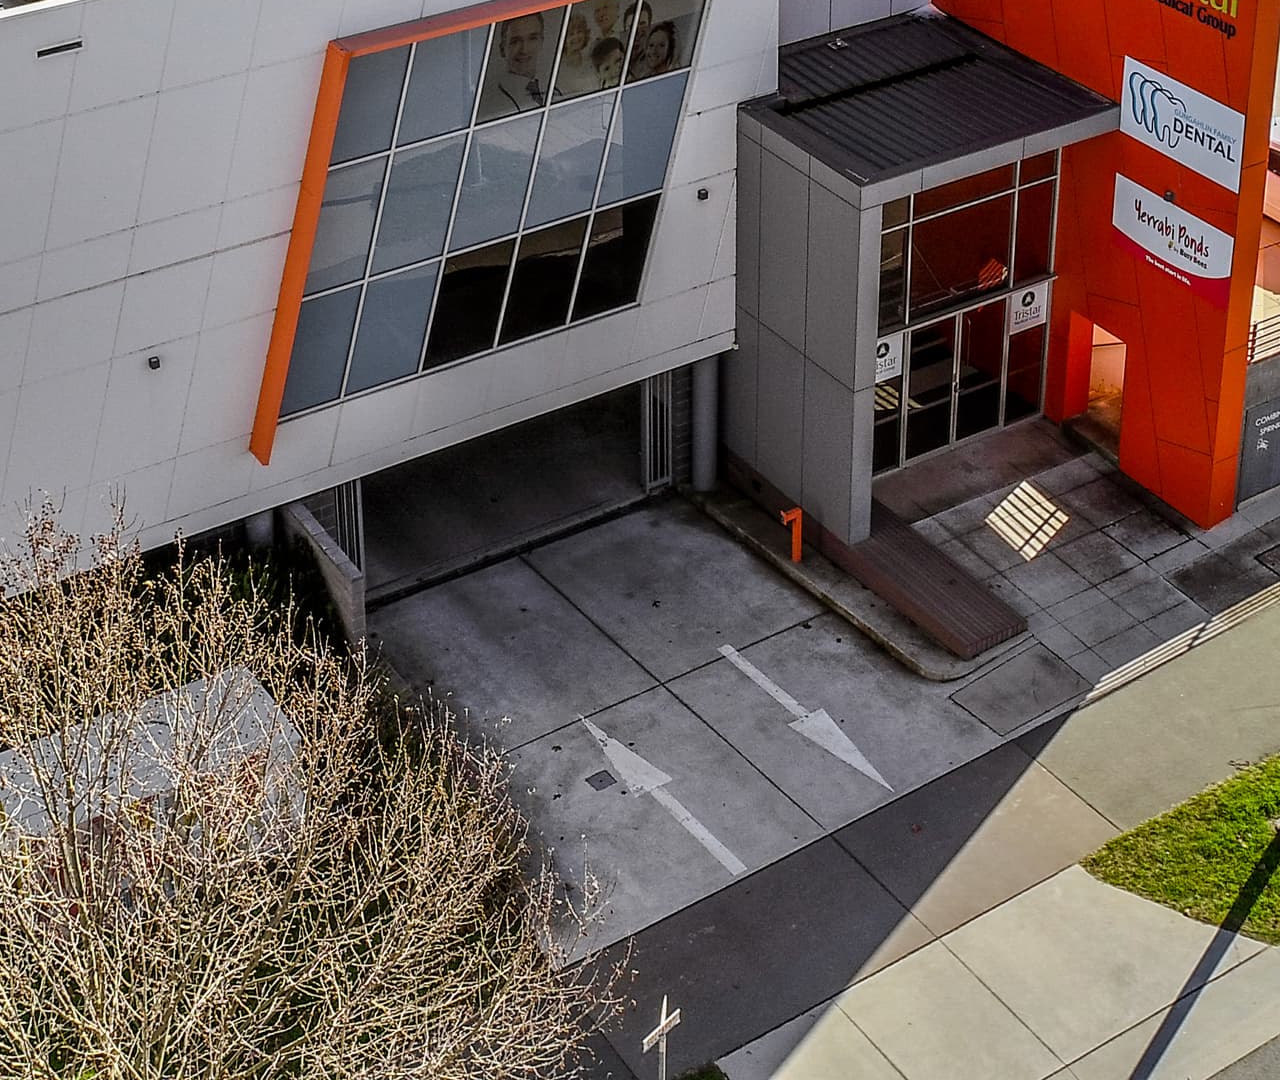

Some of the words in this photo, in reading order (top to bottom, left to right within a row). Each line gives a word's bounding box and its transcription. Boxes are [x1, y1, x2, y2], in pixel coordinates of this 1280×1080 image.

[1197, 6, 1237, 39] Group
[1173, 116, 1236, 163] DENTAL
[1213, 128, 1237, 145] FAMILY
[1134, 198, 1175, 240] Yerrabi
[1178, 223, 1209, 258] Ponds
[1014, 304, 1041, 321] Tristar
